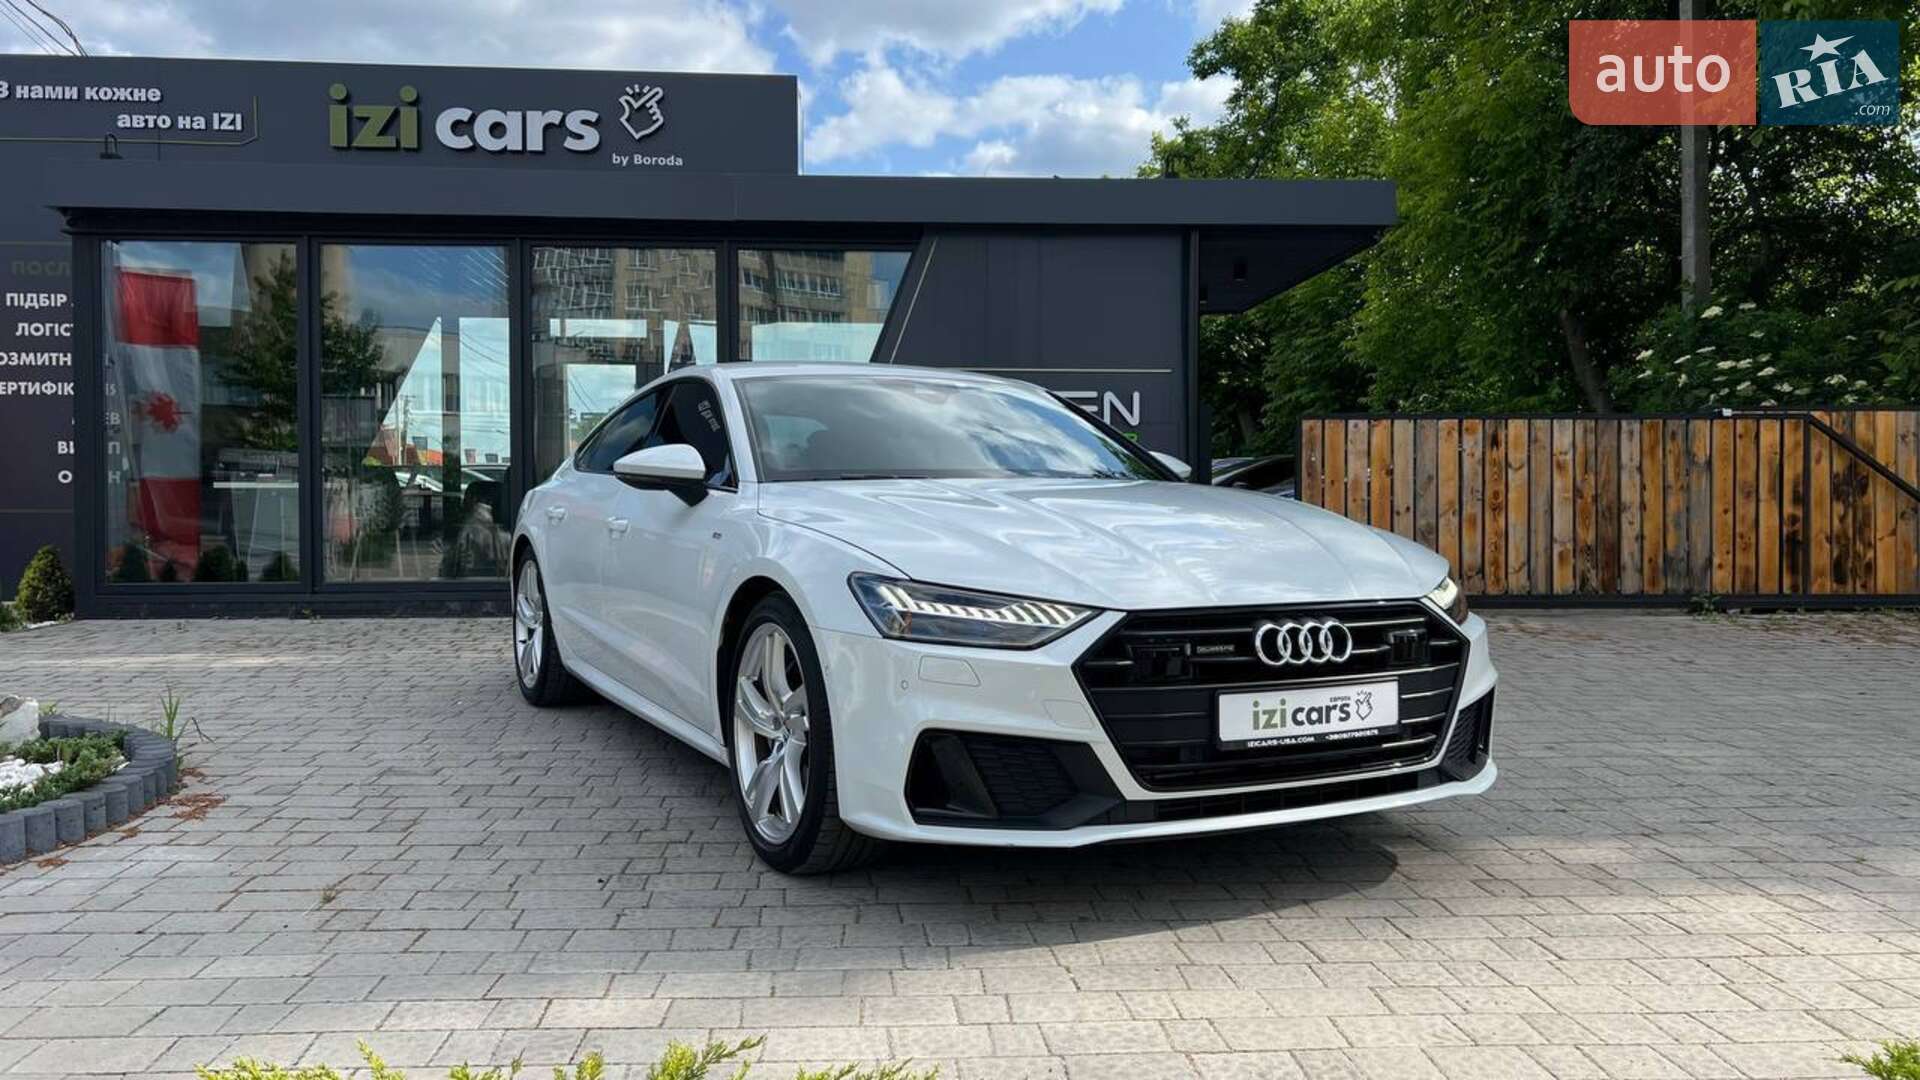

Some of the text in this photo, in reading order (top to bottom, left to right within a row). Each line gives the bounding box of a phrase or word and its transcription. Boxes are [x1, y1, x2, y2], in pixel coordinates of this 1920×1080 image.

[16, 84, 78, 100] нами
[85, 85, 162, 101] кожне
[117, 113, 243, 131] авто на IZI
[329, 83, 600, 152] izi cars
[612, 152, 683, 167] by Boroda
[5, 293, 68, 309] ПІДБІР
[15, 322, 73, 337] ЛОГІС
[1252, 698, 1351, 730] izi cars
